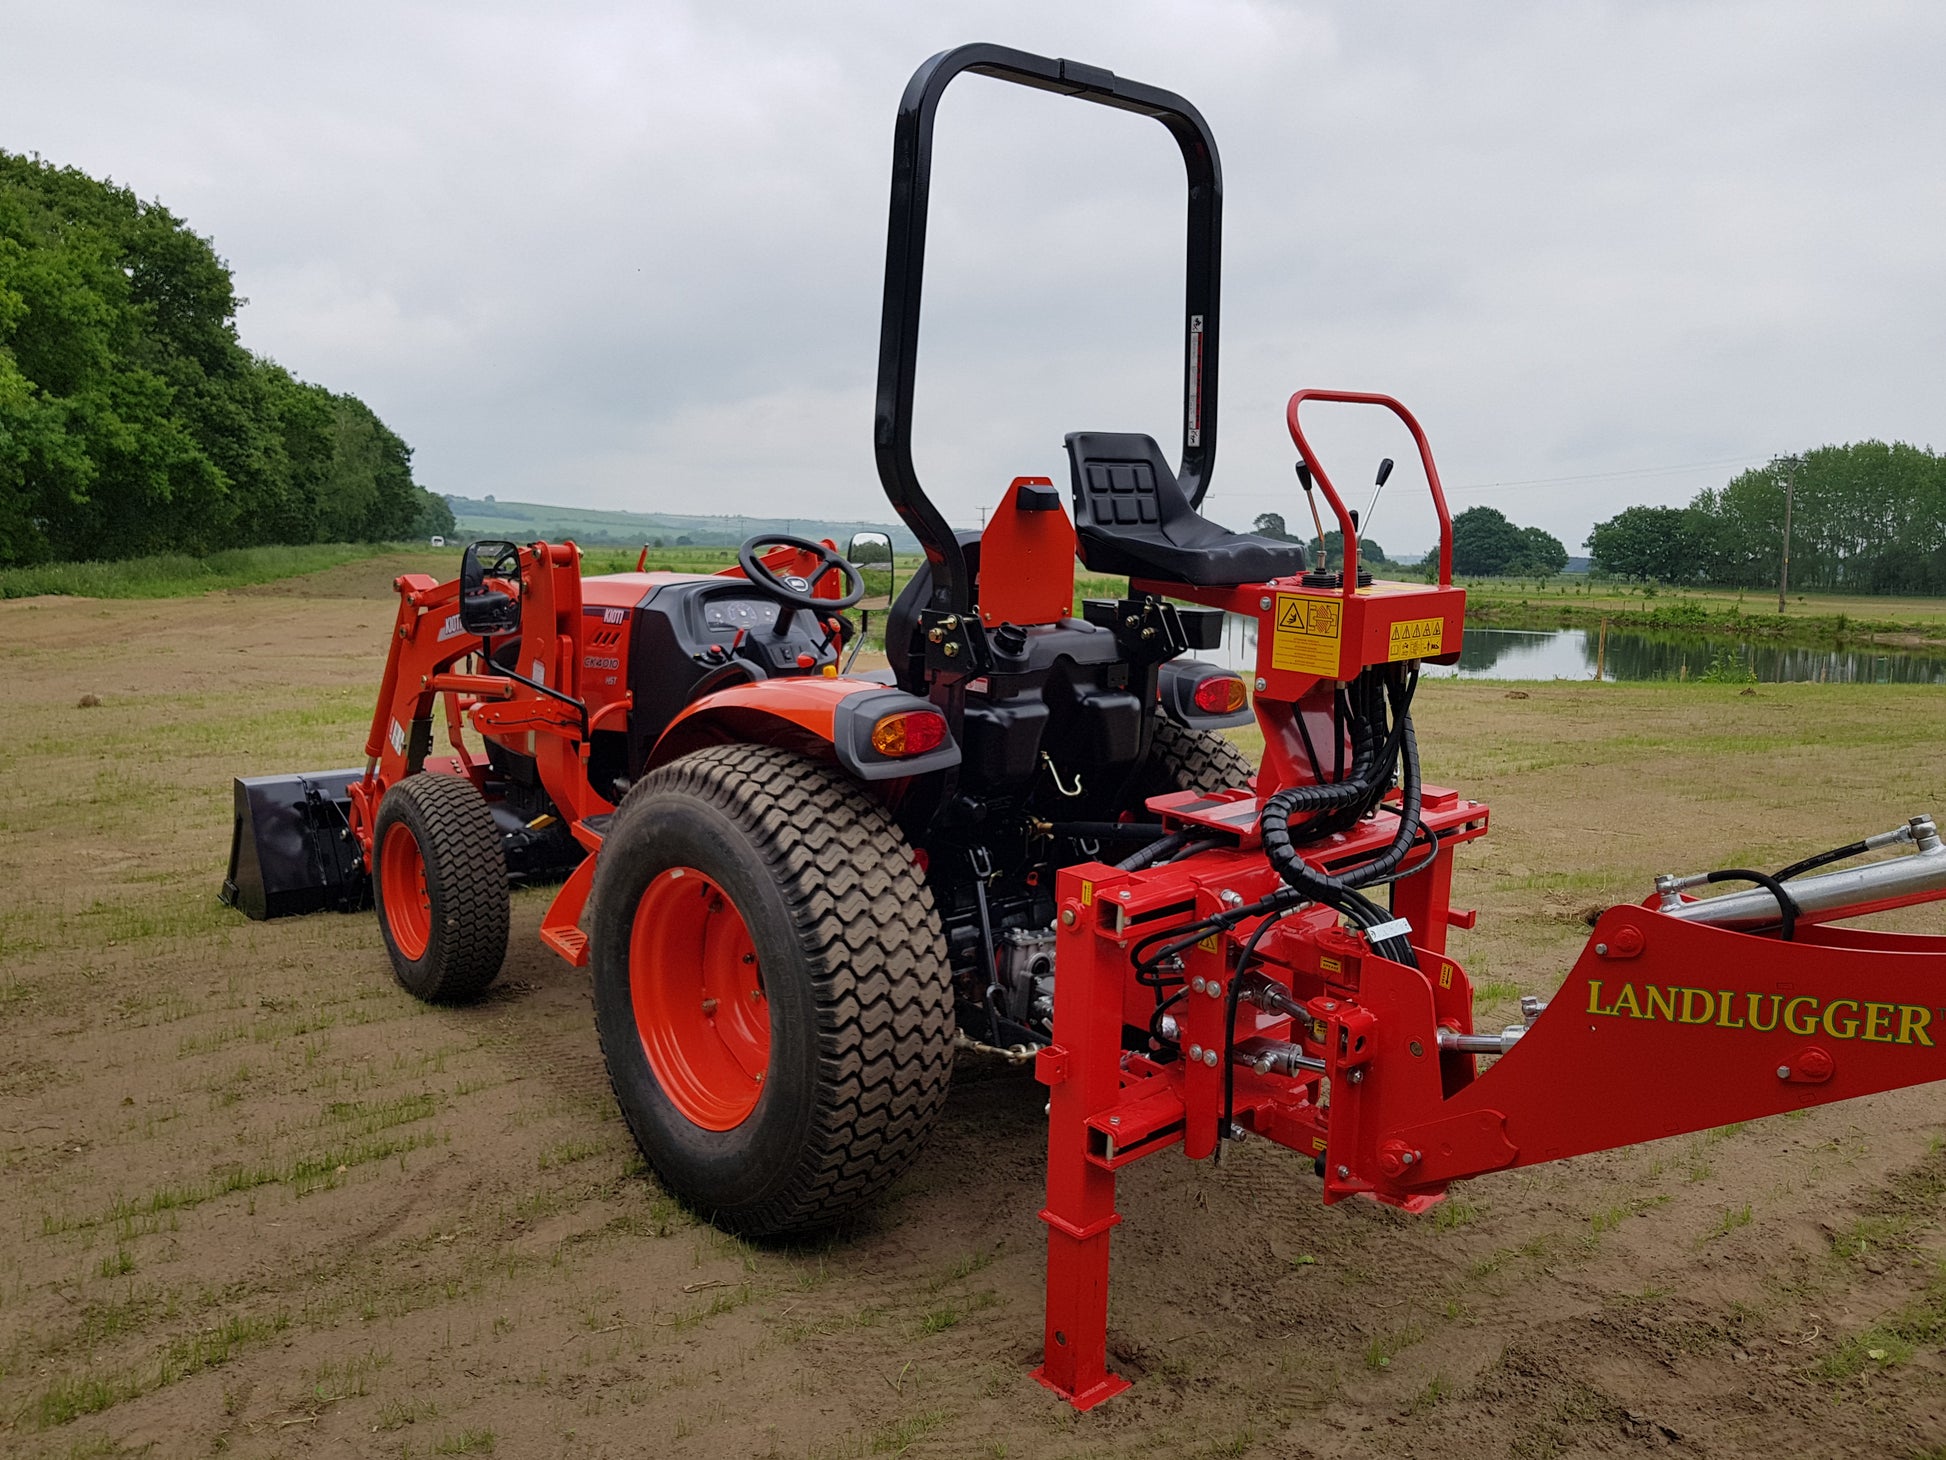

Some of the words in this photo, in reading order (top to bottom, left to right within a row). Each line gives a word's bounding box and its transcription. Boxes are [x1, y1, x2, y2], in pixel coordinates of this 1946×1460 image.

[603, 608, 625, 625] KIOTI
[584, 655, 619, 671] CK4010
[1586, 979, 1936, 1047] LANDLUGGER
